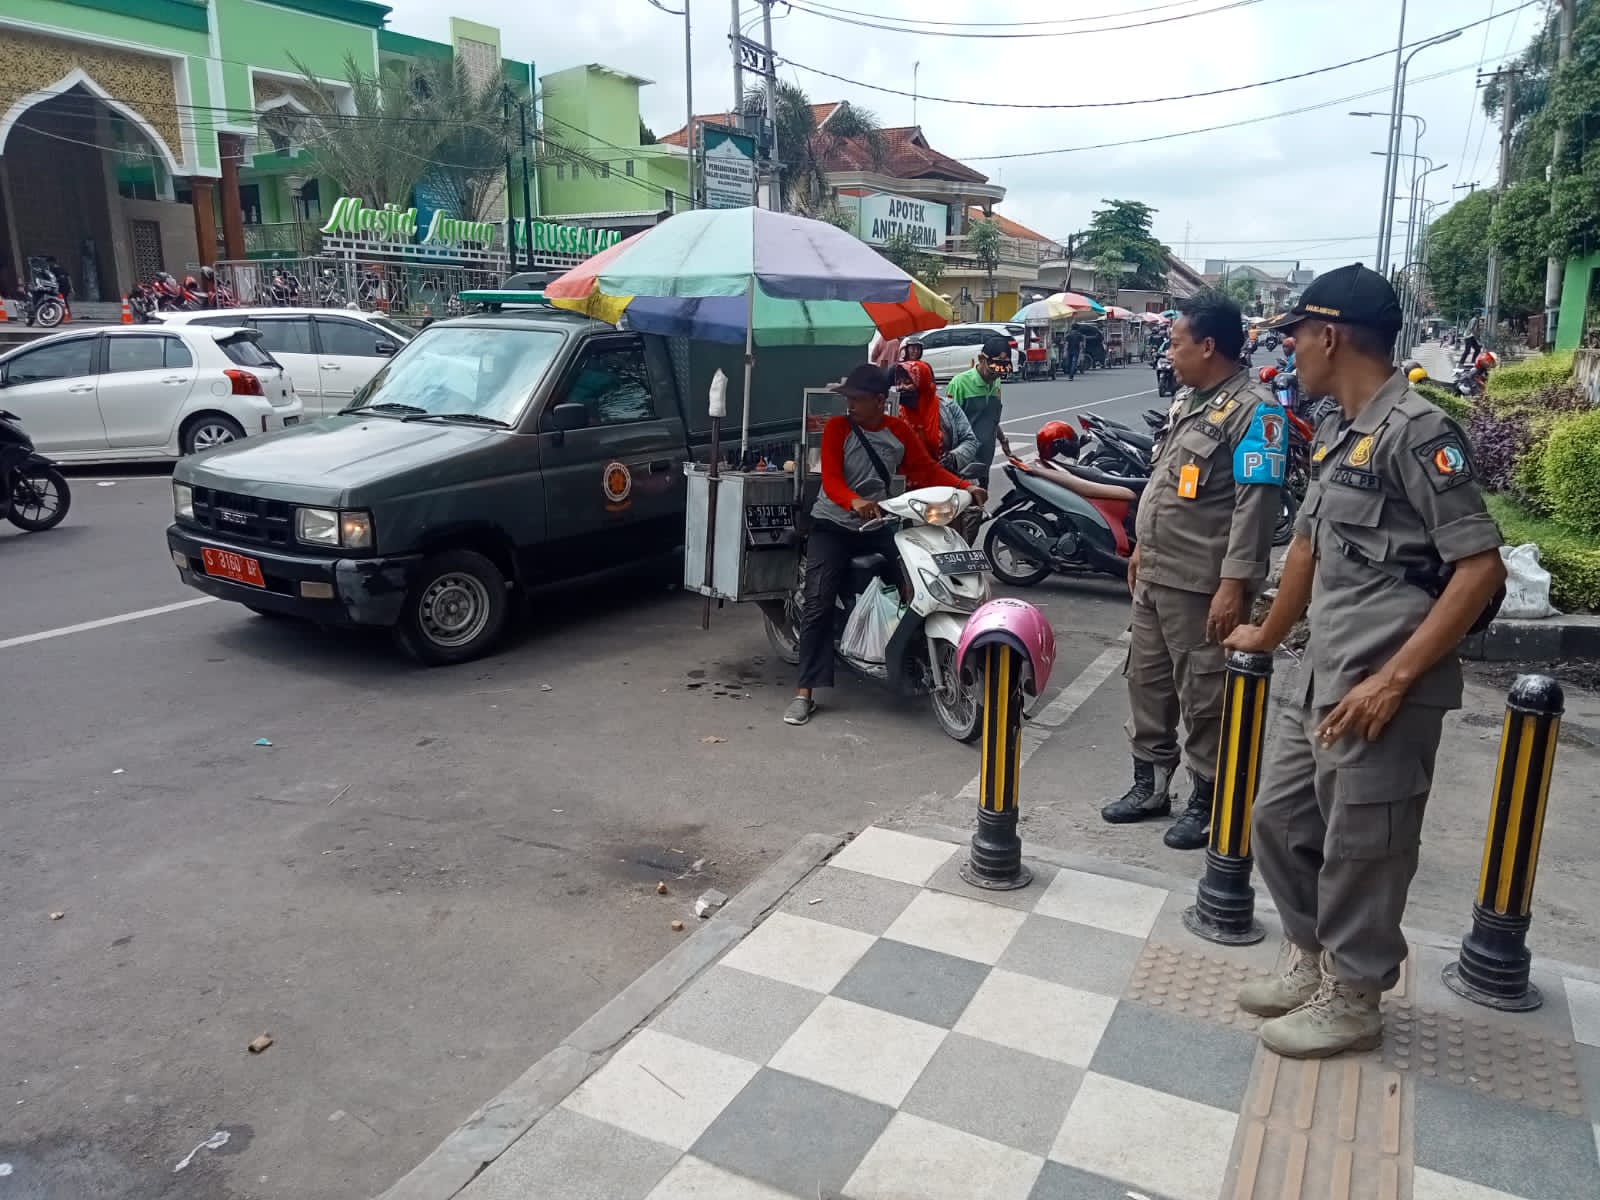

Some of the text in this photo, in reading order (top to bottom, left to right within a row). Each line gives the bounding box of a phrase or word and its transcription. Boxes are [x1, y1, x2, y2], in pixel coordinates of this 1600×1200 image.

[320, 197, 418, 242] Masjid
[422, 208, 495, 250] Agung
[889, 199, 925, 223] APOTEK
[872, 218, 937, 246] ANITA FARMA
[205, 550, 214, 566] S
